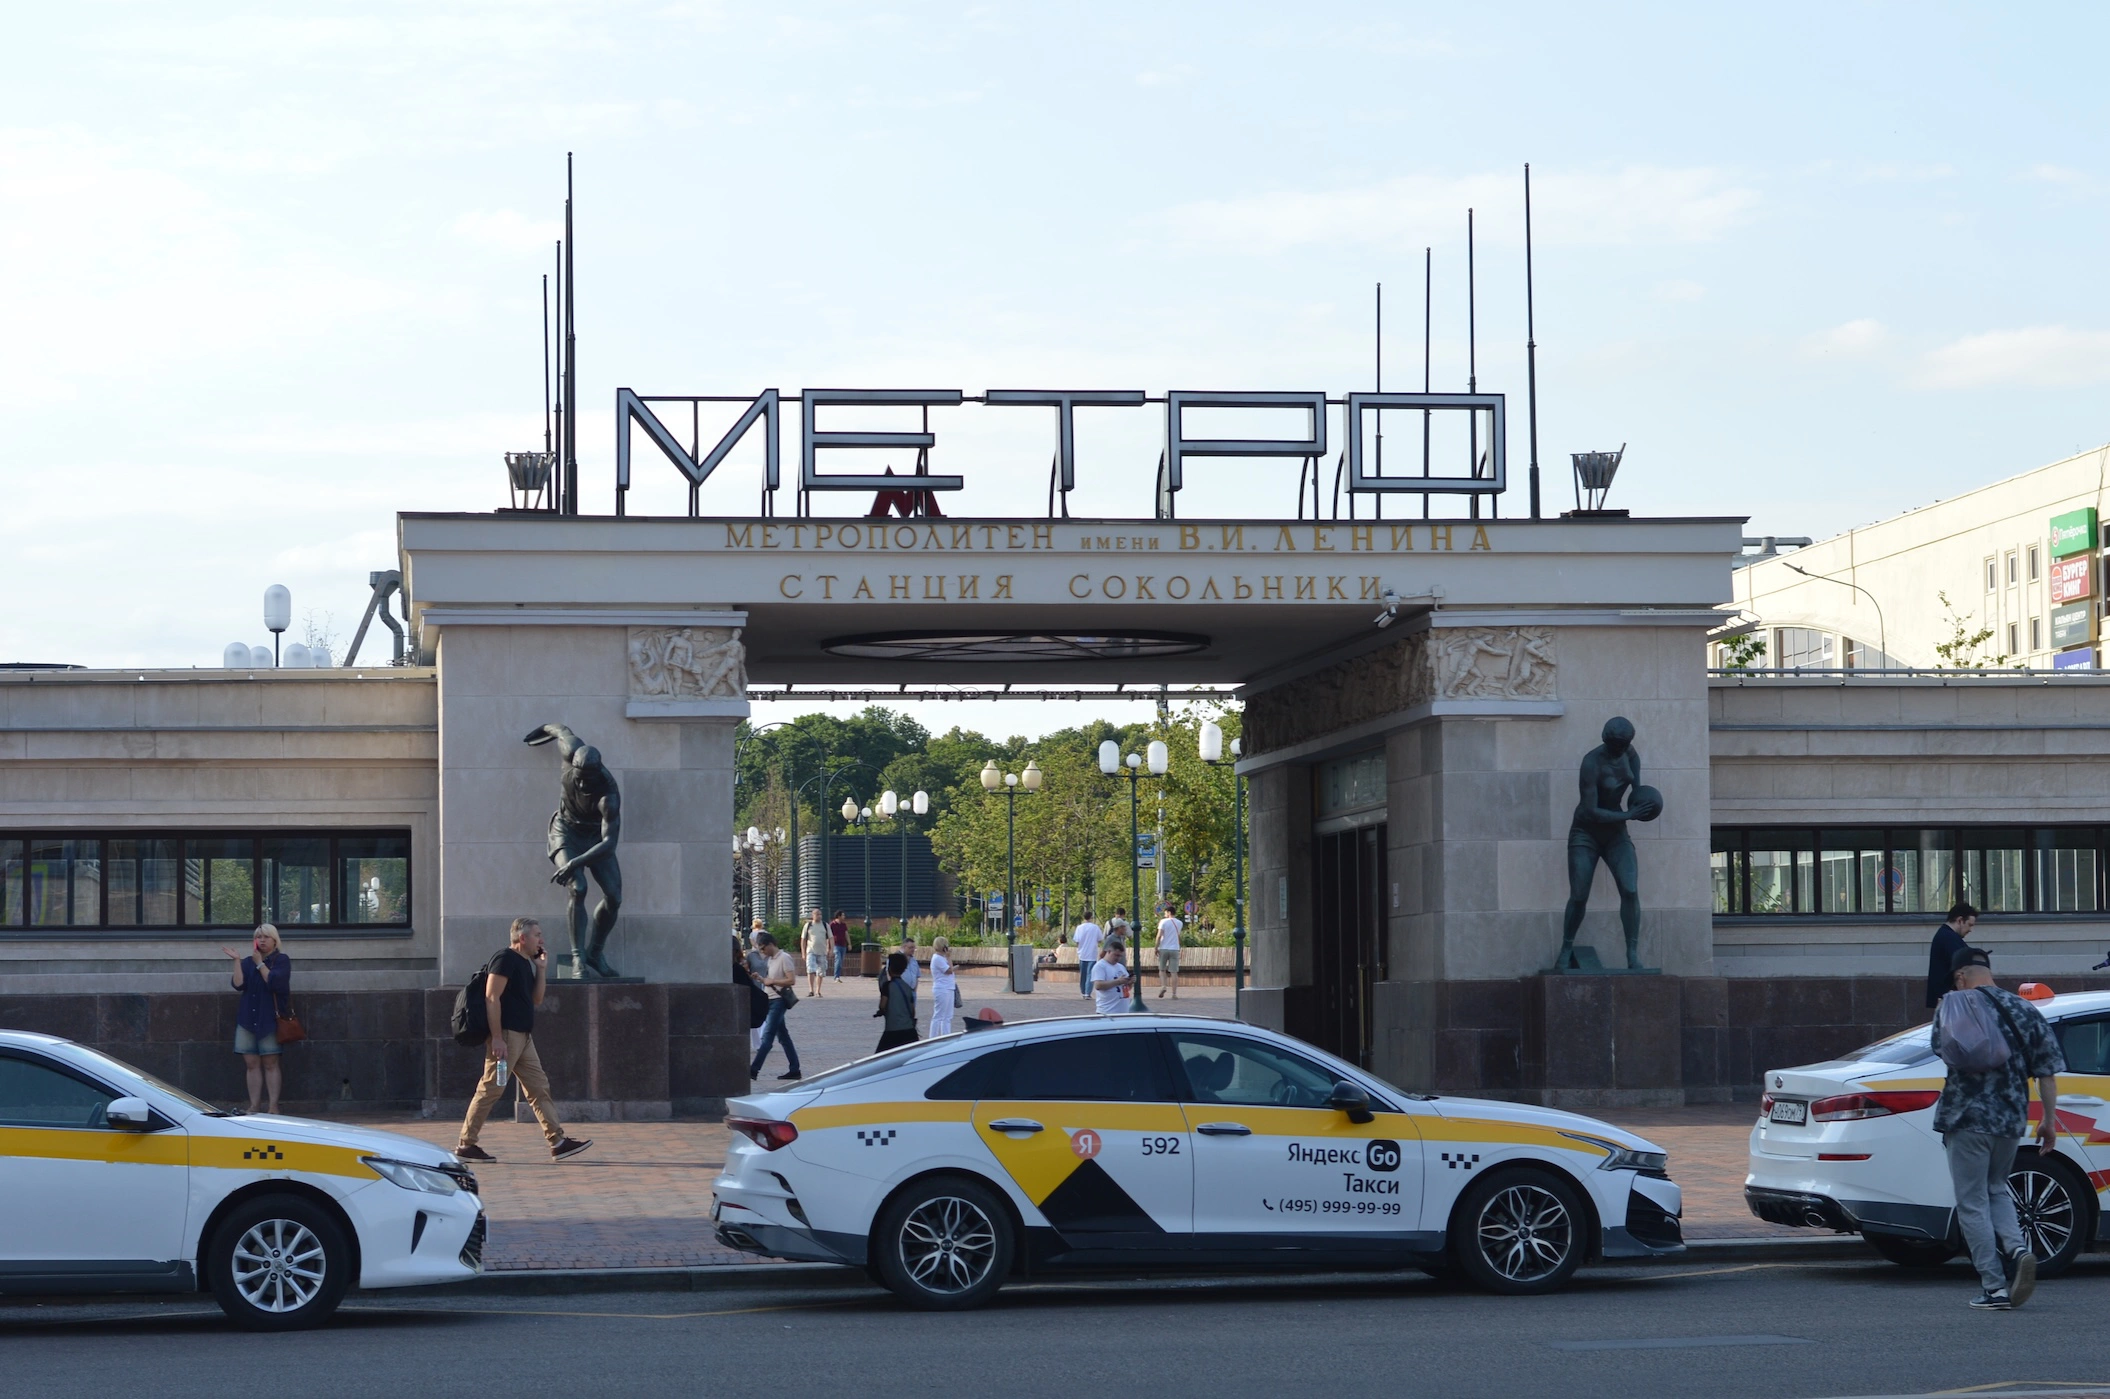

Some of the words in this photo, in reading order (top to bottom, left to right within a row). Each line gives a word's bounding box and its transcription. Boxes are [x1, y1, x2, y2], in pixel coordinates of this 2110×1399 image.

[616, 388, 1506, 494] МЕТРО
[725, 524, 1054, 550] МЕТРОПОЛИТЕН
[1179, 525, 1257, 551] В.И.
[1274, 525, 1492, 551] ЛЕНИНА
[2062, 560, 2088, 581] БУРГЕР
[780, 575, 1013, 601] СТАНЦИЯ
[1069, 574, 1382, 600] СОКОЛЬНИКИ
[2063, 579, 2081, 598] КИНГ
[1079, 1134, 1093, 1154] Я
[1142, 1137, 1180, 1155] 592
[1288, 1143, 1361, 1165] Яндекс
[1369, 1145, 1398, 1166] Go
[1343, 1173, 1400, 1194] Такси
[1280, 1199, 1317, 1214] (495)
[1322, 1200, 1401, 1215] 999-99-99
